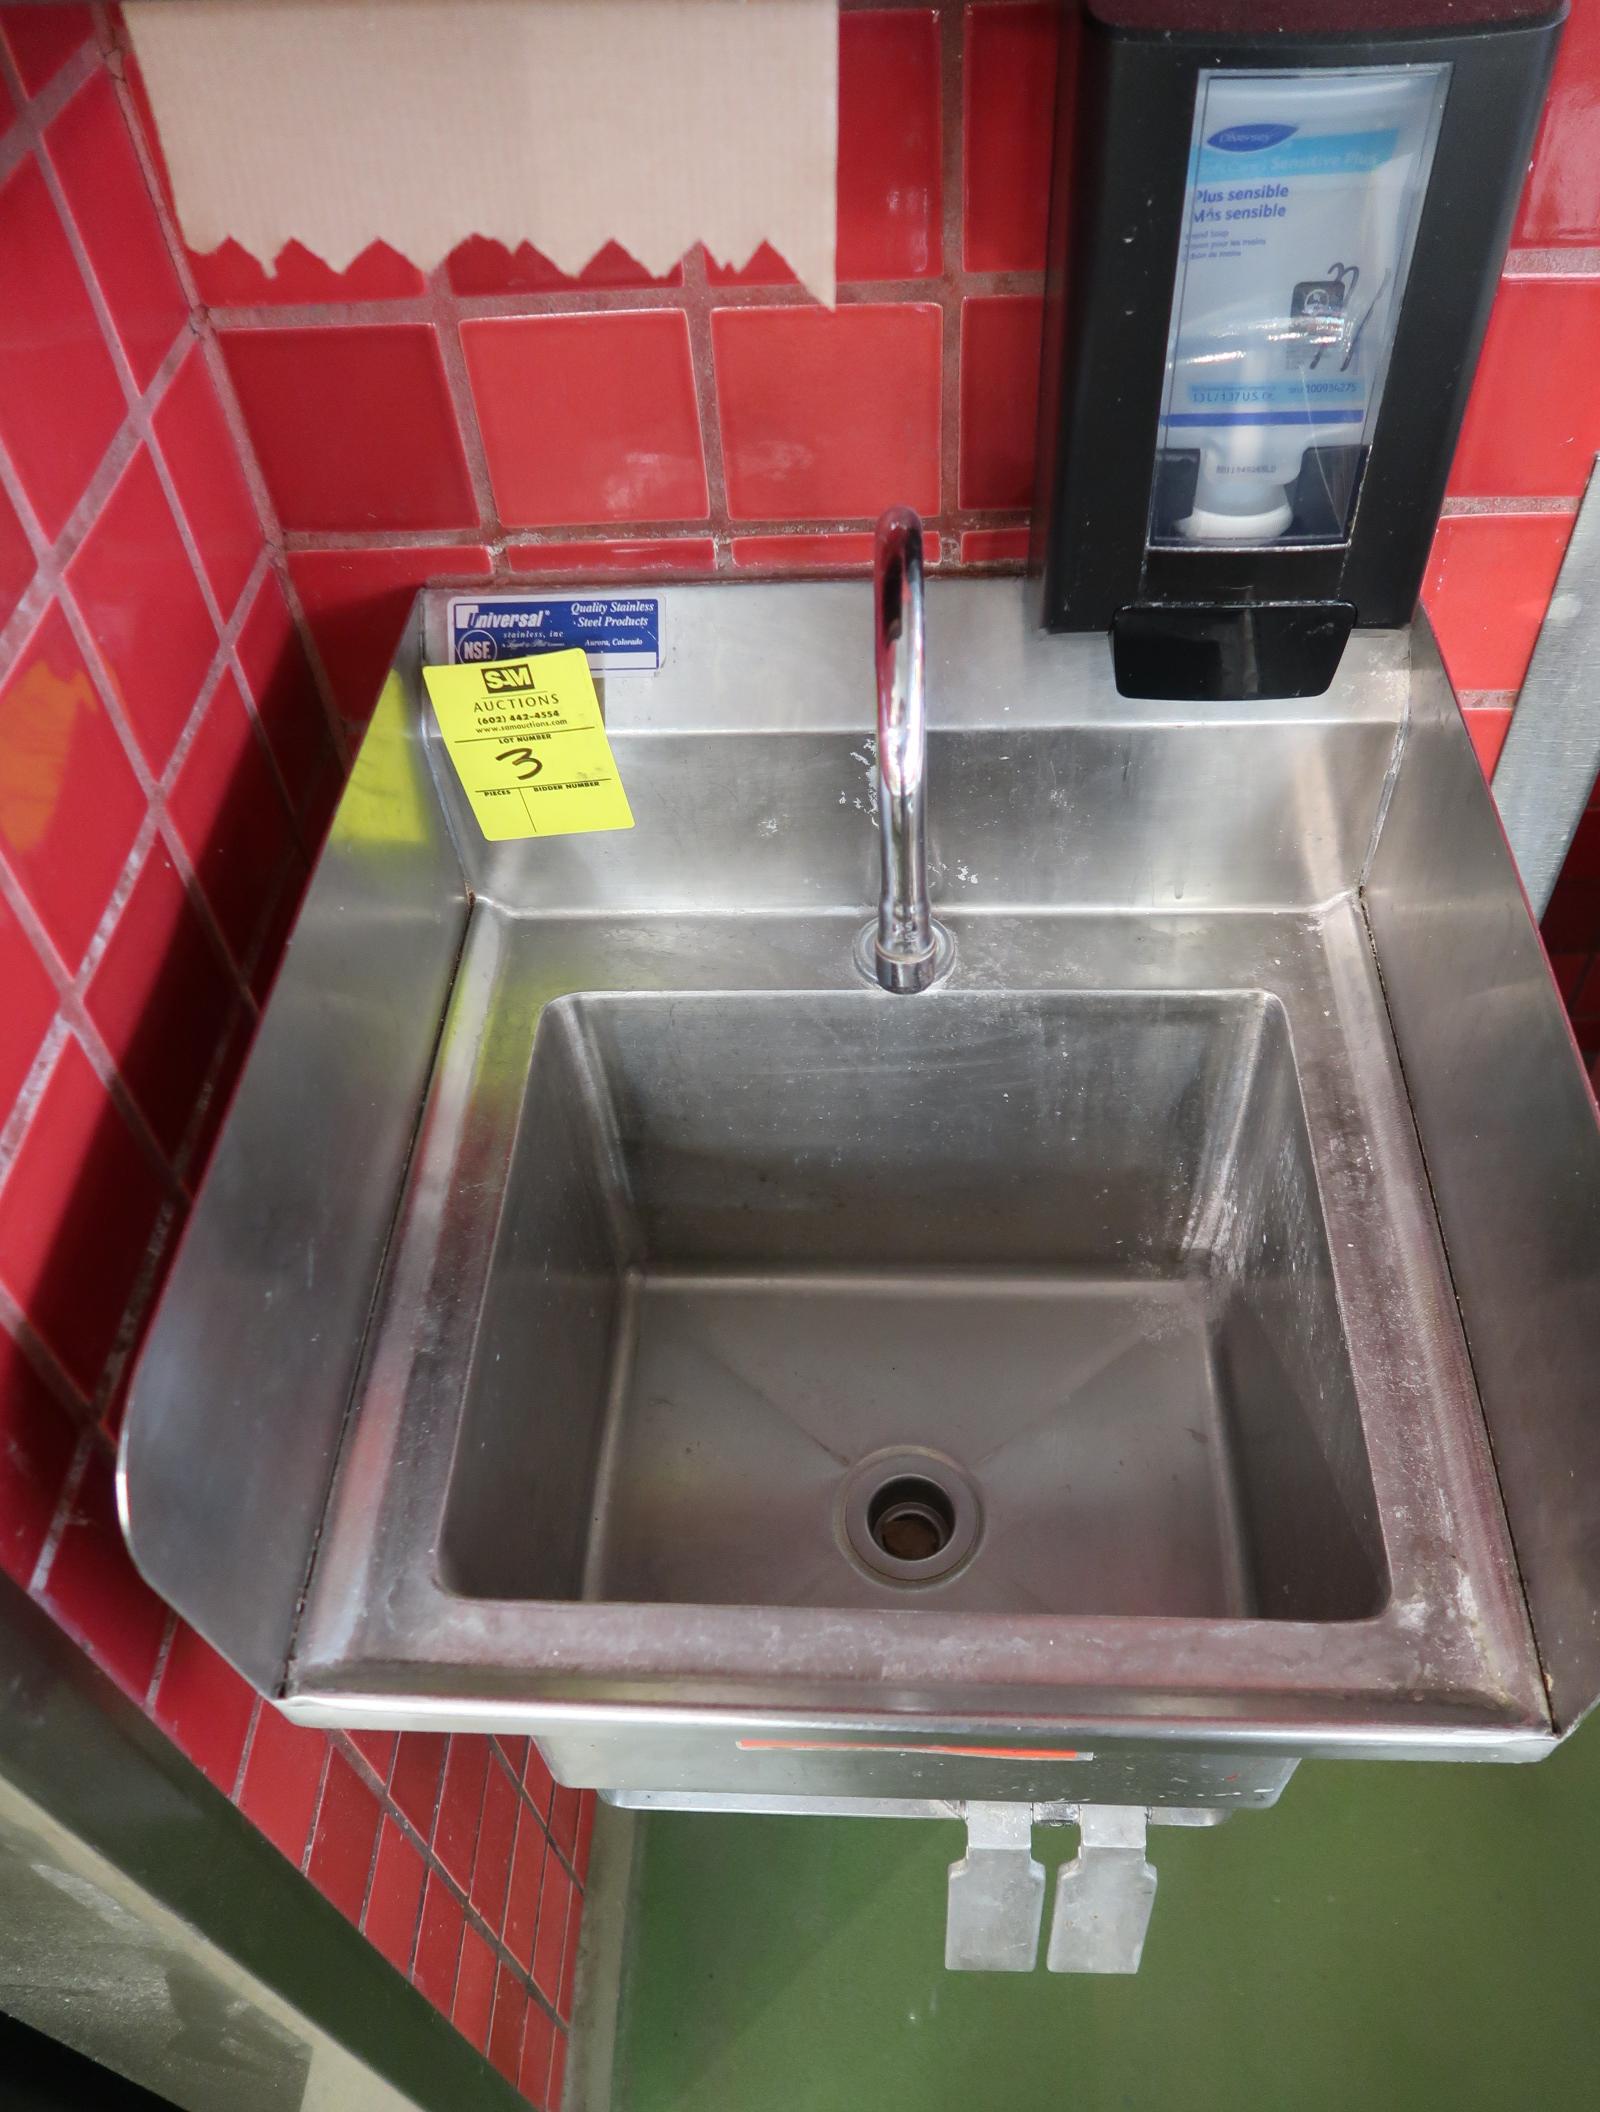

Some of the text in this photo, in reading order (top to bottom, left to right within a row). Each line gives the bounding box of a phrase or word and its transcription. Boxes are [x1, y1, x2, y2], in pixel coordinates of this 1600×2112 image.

[1228, 184, 1289, 201] sensible
[1225, 203, 1287, 220] sensible
[455, 604, 545, 629] Universal
[571, 601, 654, 616] Quality Stainless
[577, 615, 649, 628] Steel Products
[473, 693, 560, 713] AUCTIONS
[477, 709, 560, 726] (602) 442-4554
[475, 719, 568, 734] www.samauctions.com
[498, 733, 552, 745] LOT NUMBER
[495, 747, 543, 780] 3
[484, 788, 511, 797] PIECES
[533, 780, 600, 793] BIDDER NUMBER
